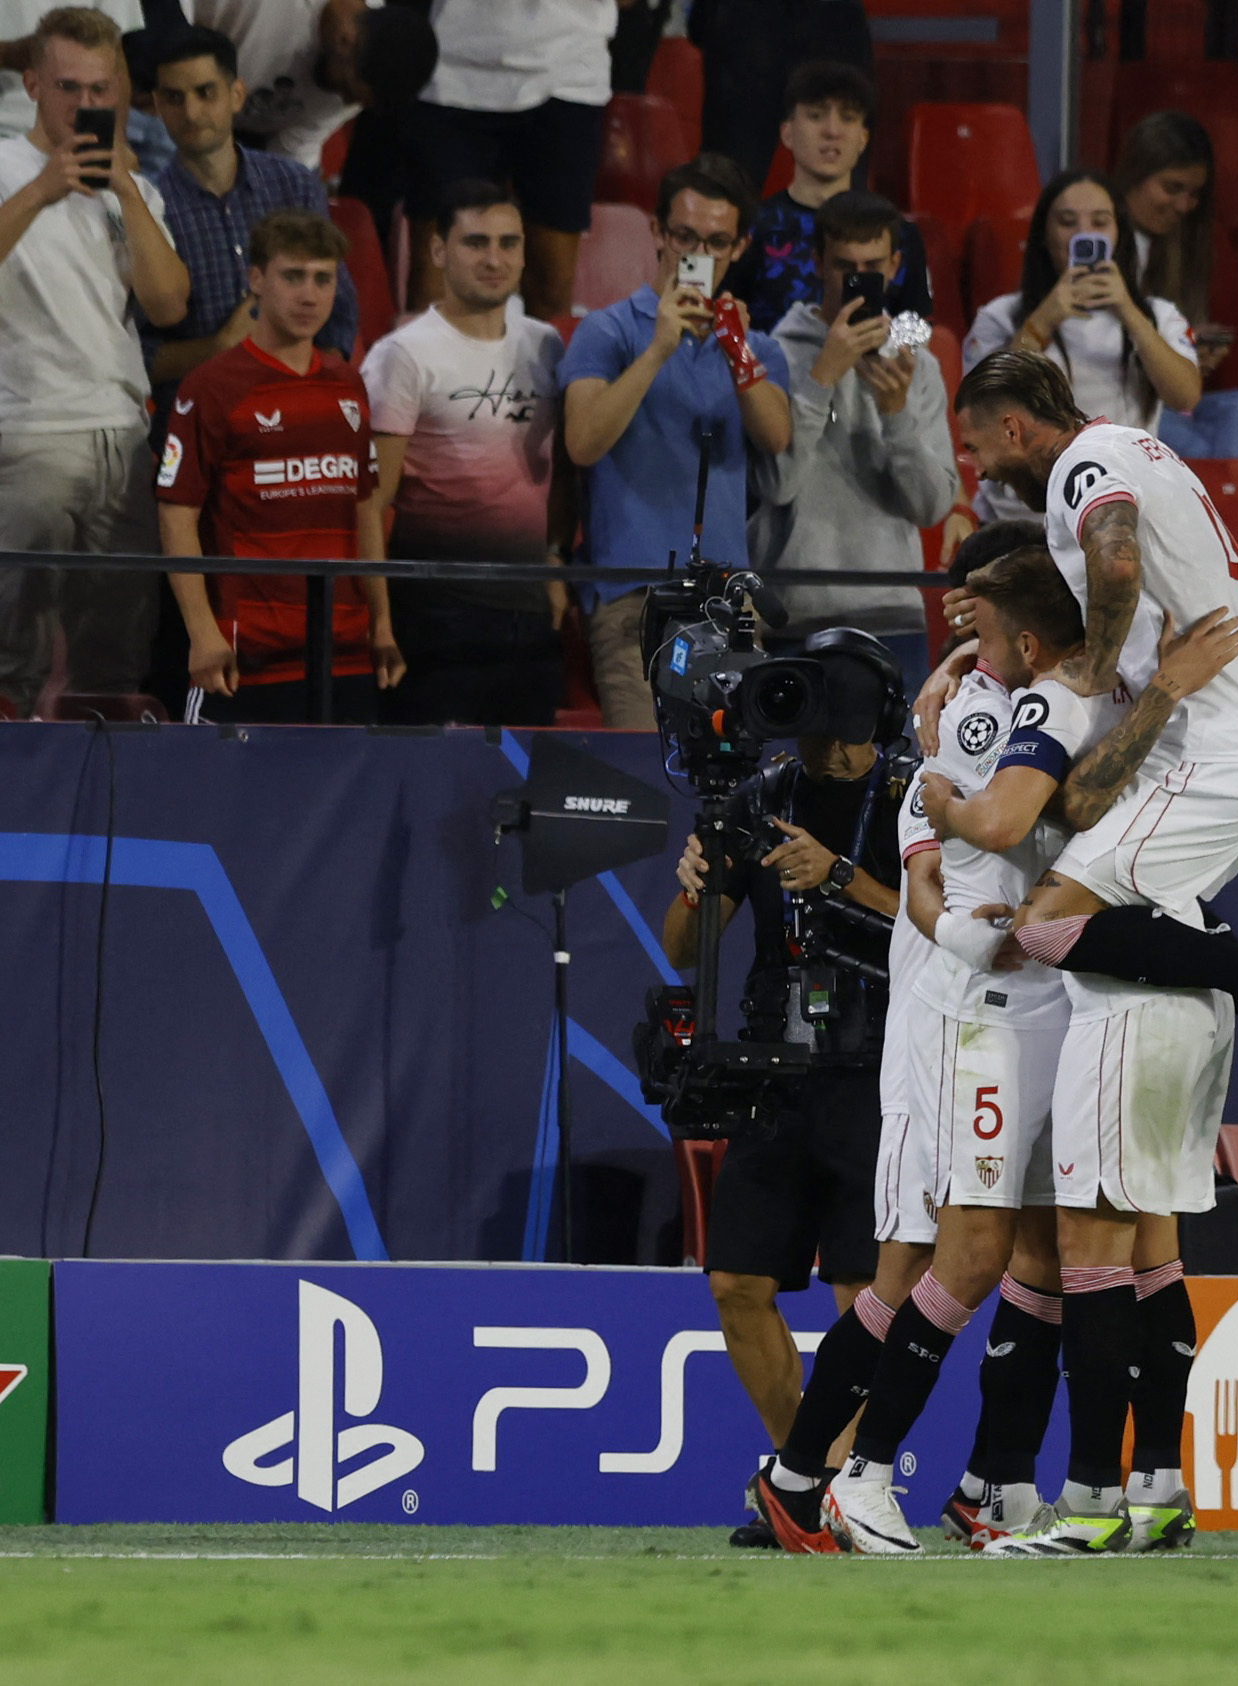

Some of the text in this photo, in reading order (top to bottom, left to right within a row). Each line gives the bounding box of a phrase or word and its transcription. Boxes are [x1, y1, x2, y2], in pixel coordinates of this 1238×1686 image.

[285, 455, 359, 482] DEGR
[564, 796, 629, 815] SHURE
[973, 1085, 1004, 1141] 5
[907, 1342, 940, 1363] SFC
